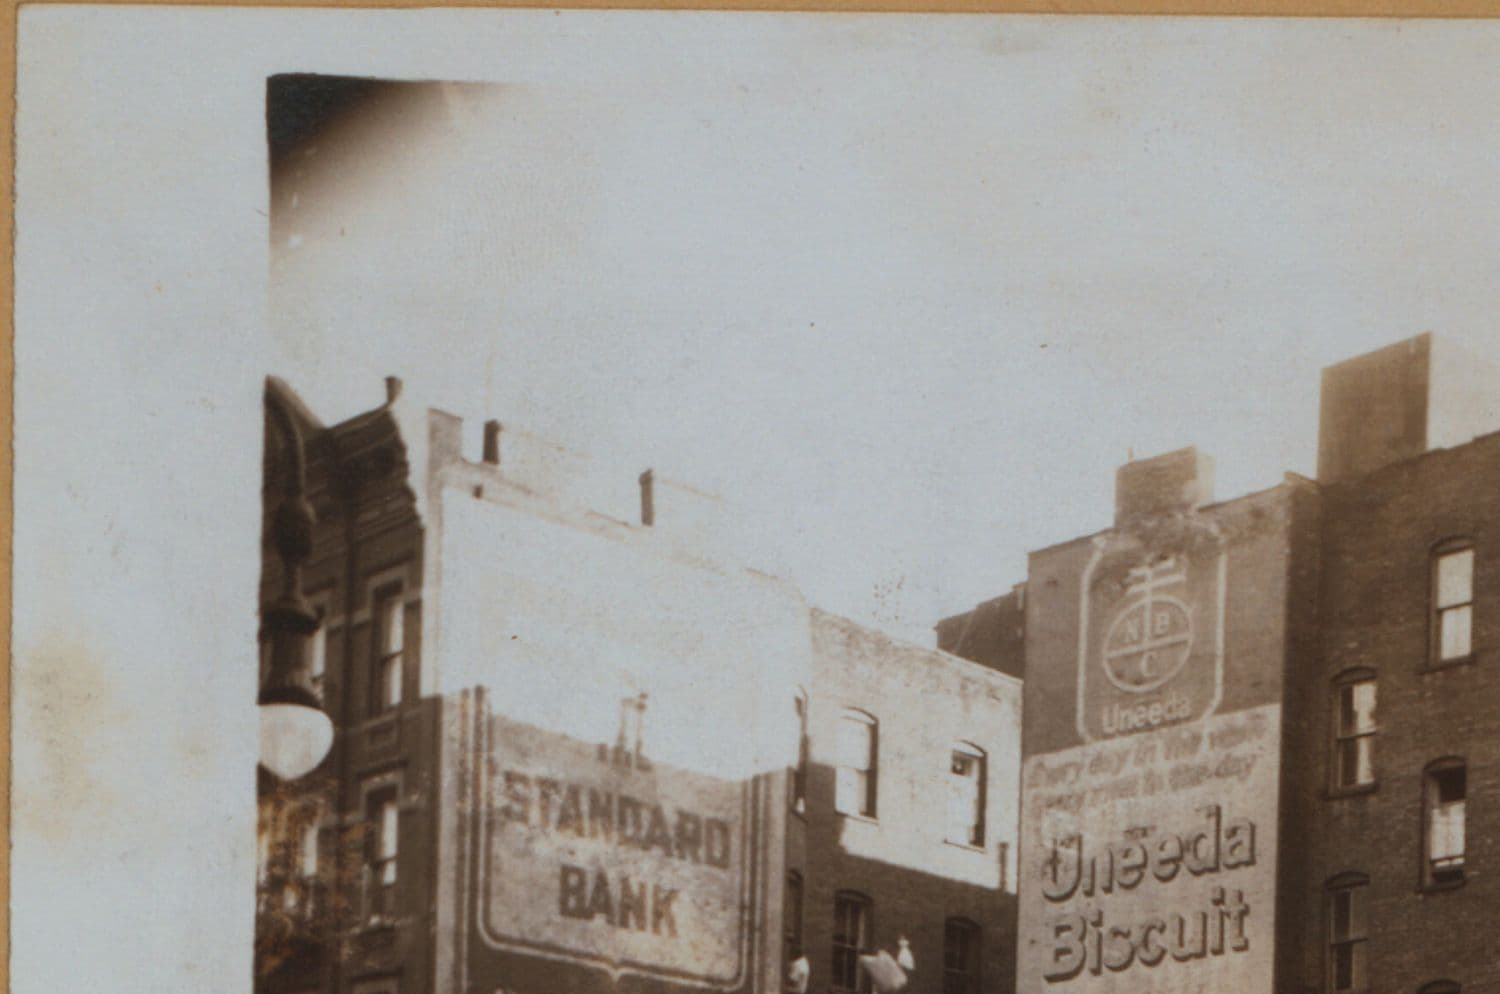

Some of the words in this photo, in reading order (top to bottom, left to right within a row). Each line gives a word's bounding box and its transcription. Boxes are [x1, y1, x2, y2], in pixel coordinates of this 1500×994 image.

[1101, 692, 1193, 732] Uneeda
[500, 769, 731, 870] STANDARD
[1042, 804, 1257, 903] Uneeda
[558, 864, 680, 939] BANK
[1042, 887, 1250, 984] Biscuit
